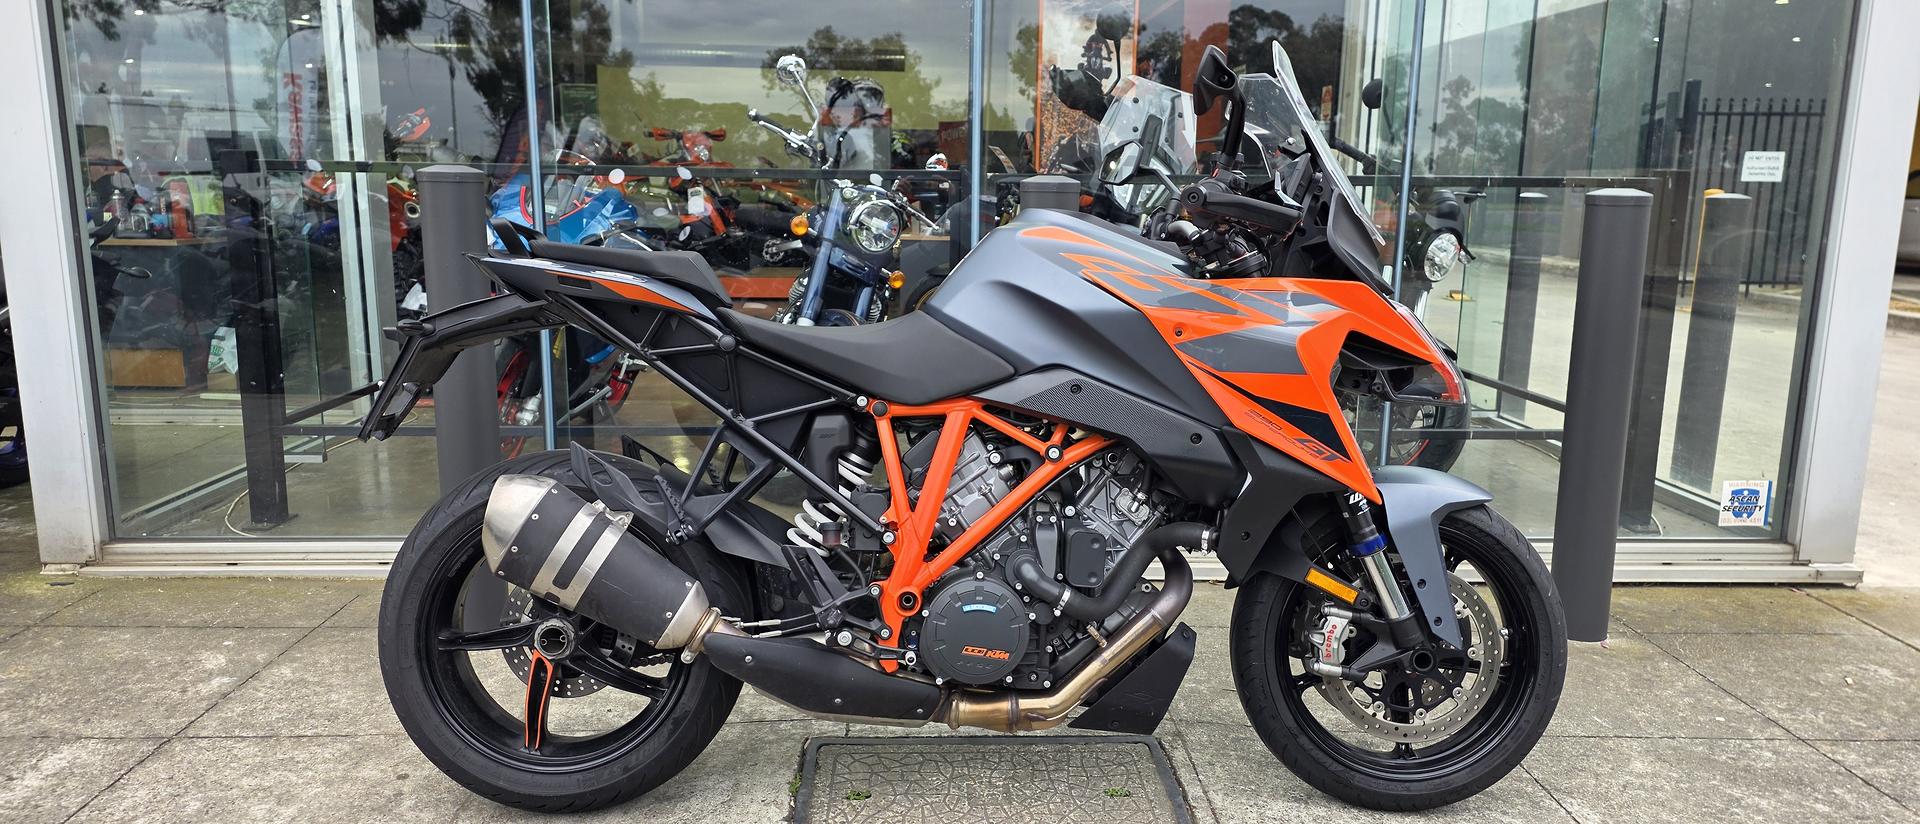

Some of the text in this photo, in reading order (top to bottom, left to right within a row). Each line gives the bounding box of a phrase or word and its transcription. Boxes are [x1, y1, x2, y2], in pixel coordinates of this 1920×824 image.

[1294, 437, 1353, 463] GT
[1721, 504, 1764, 512] SECURITY
[1324, 624, 1338, 658] brembo
[986, 650, 1010, 660] KTM
